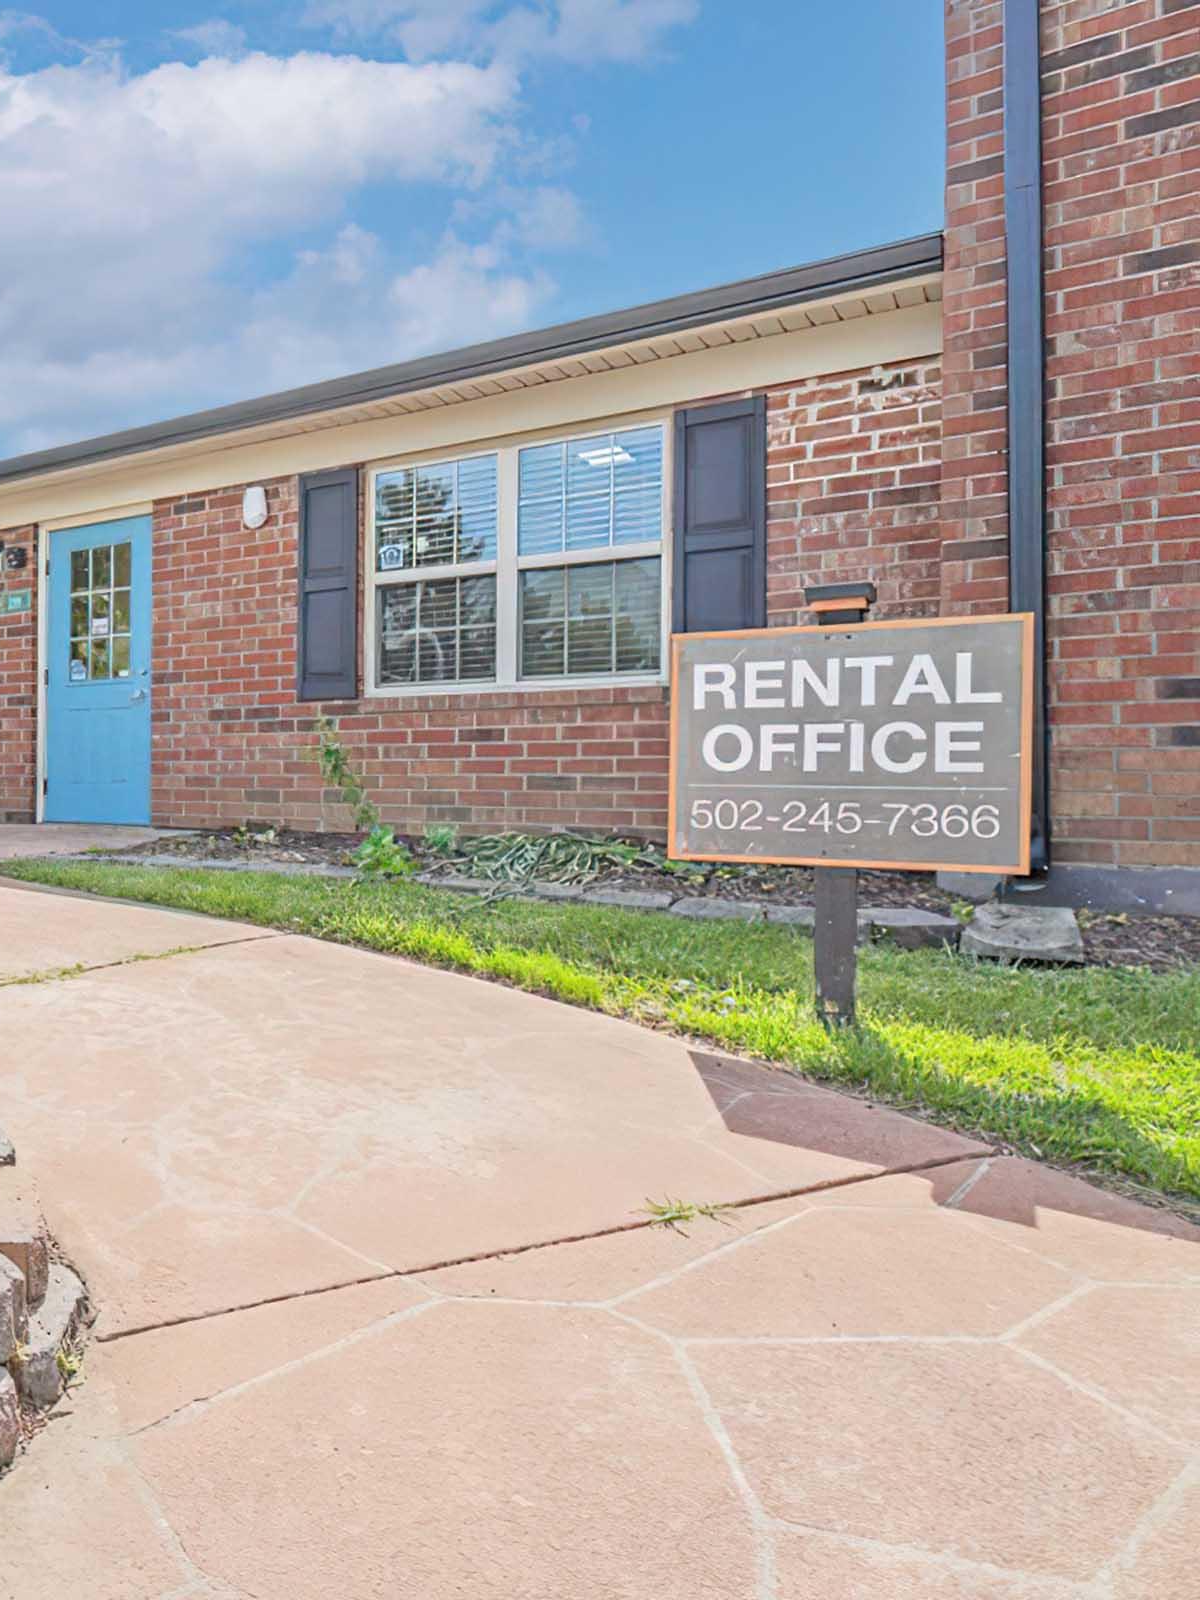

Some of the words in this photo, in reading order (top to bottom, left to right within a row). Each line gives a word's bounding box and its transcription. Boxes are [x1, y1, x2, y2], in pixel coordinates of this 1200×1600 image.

[693, 652, 1003, 710] RENTAL
[701, 720, 985, 773] OFFICE
[689, 798, 1001, 839] 502-245-7366
